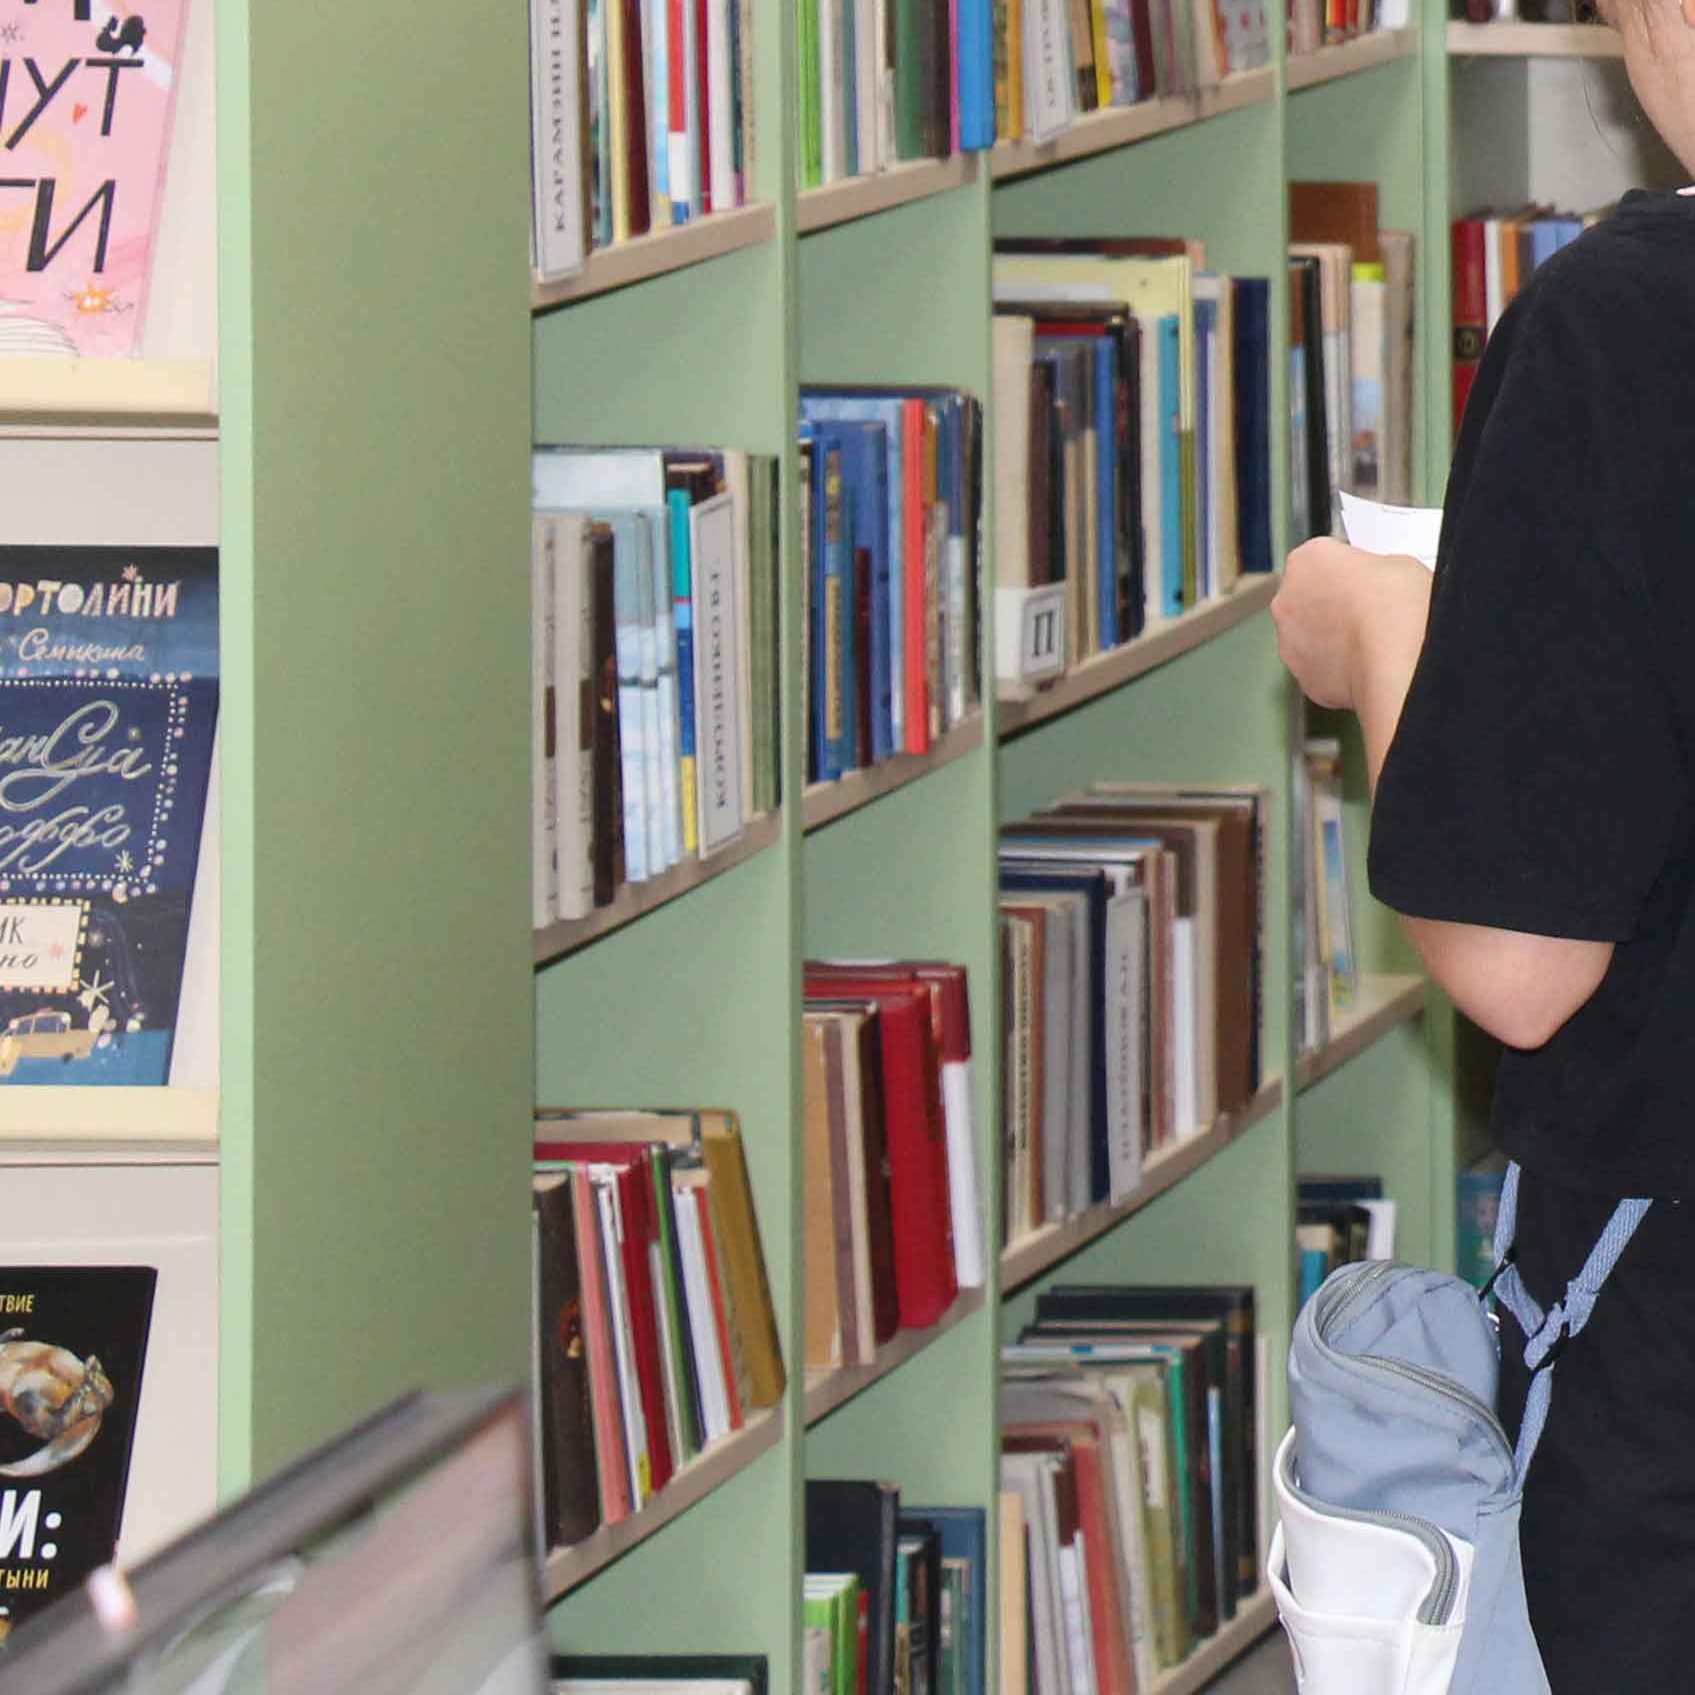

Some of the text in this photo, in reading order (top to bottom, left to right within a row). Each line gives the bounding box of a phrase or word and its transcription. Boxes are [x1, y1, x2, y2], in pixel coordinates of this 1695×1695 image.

[548, 49, 566, 232] КАРАМЗИН
[709, 613, 727, 808] КОРОЛЕНКО
[1031, 609, 1055, 656] П
